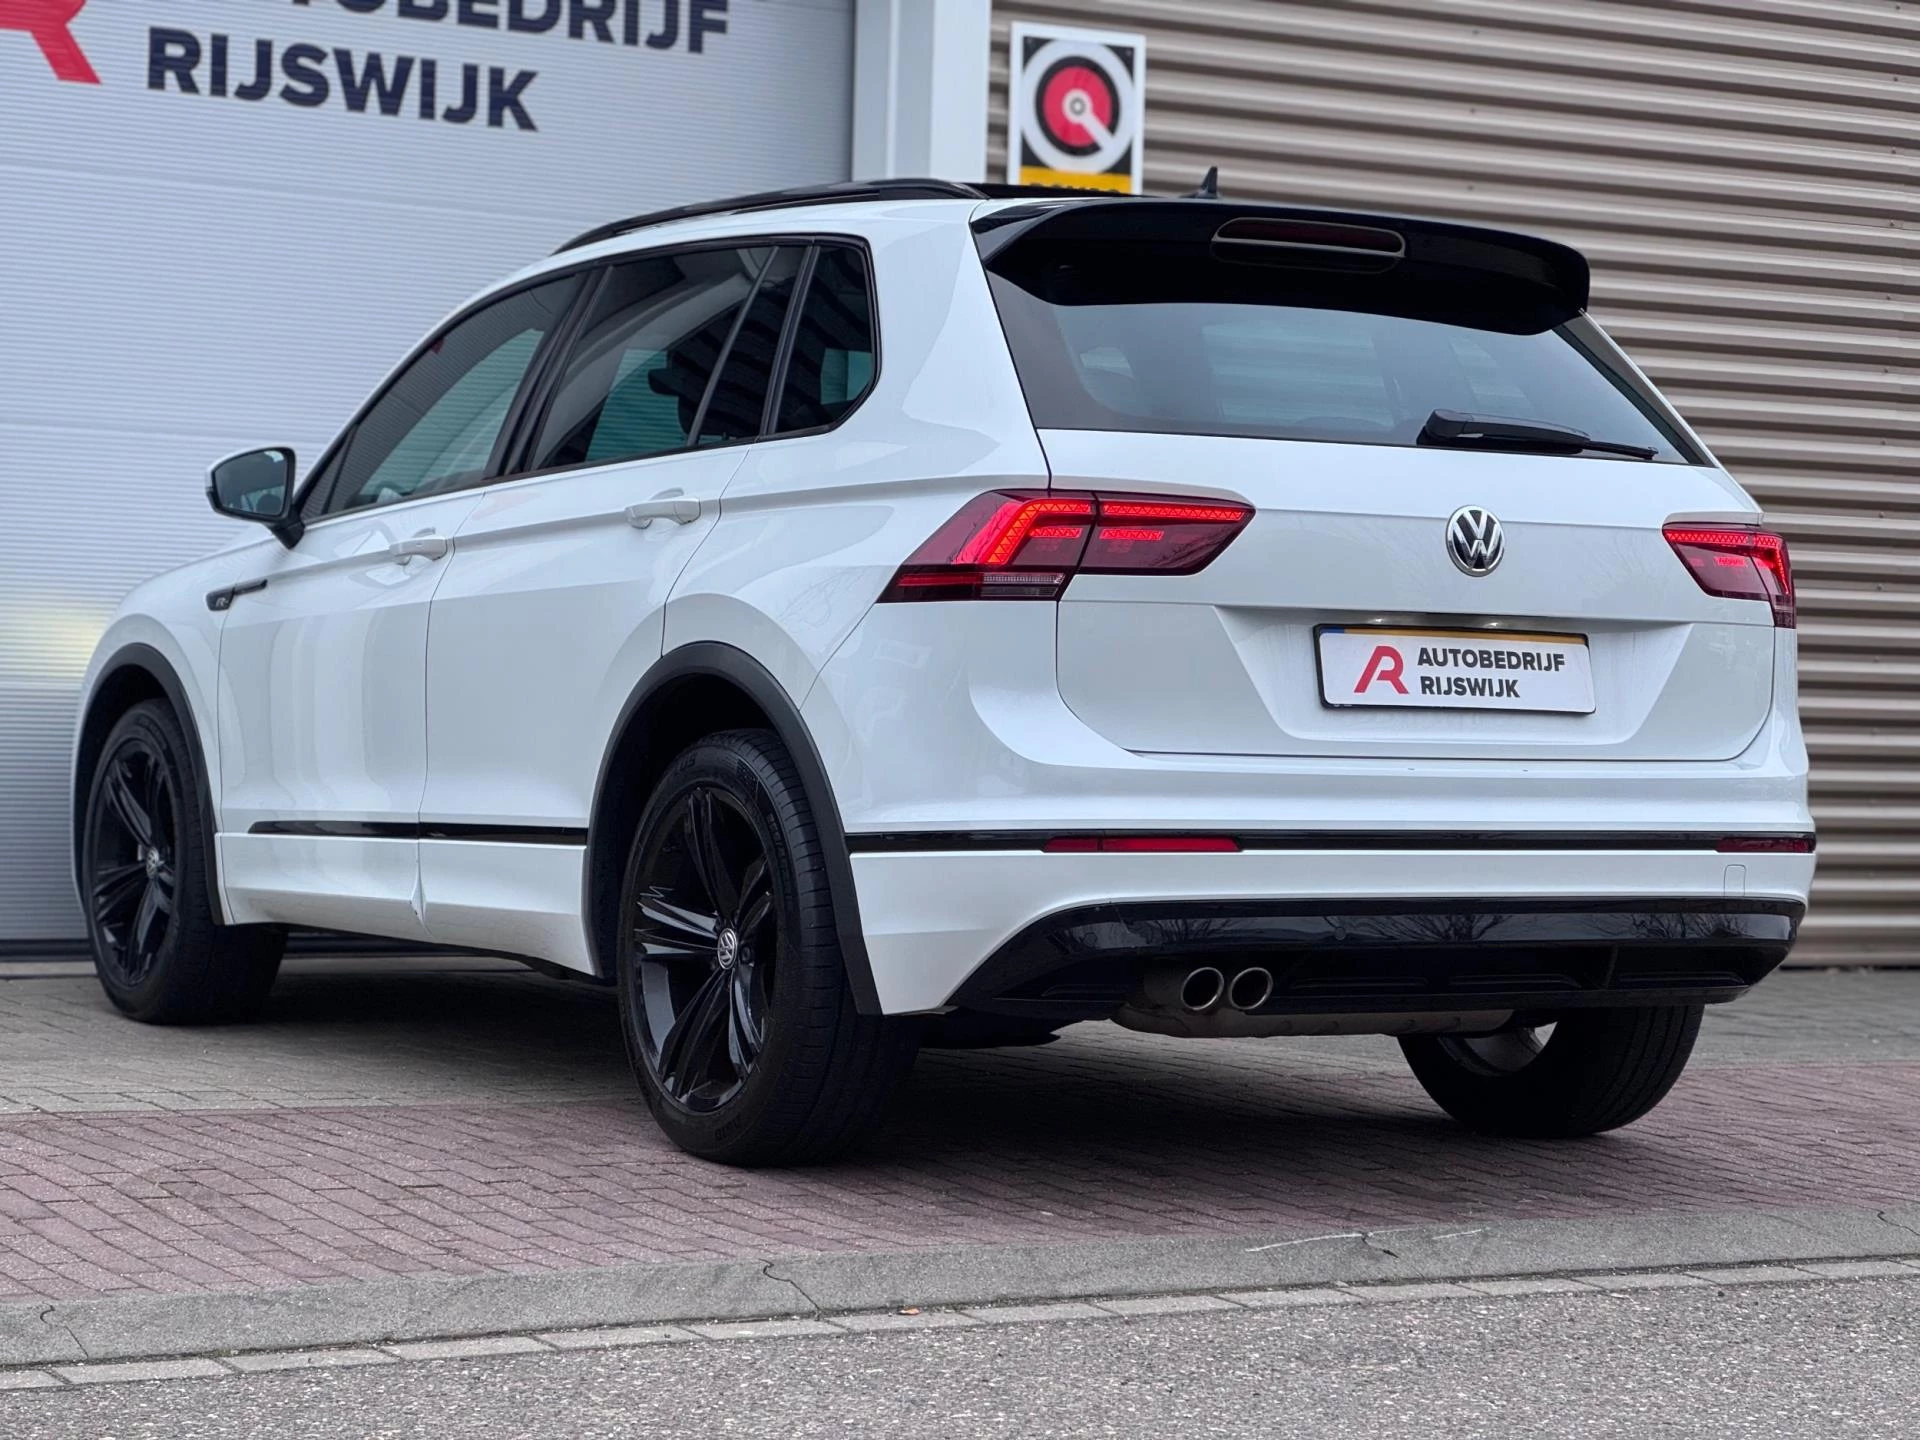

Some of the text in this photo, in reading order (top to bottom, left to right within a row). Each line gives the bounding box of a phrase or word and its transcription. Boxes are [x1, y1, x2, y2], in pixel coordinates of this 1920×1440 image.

[147, 26, 540, 131] RIJSWIJK
[1448, 505, 1503, 574] VW
[1417, 648, 1565, 672] AUTOBEDRIJF
[1421, 676, 1520, 698] RIJSWIJK
